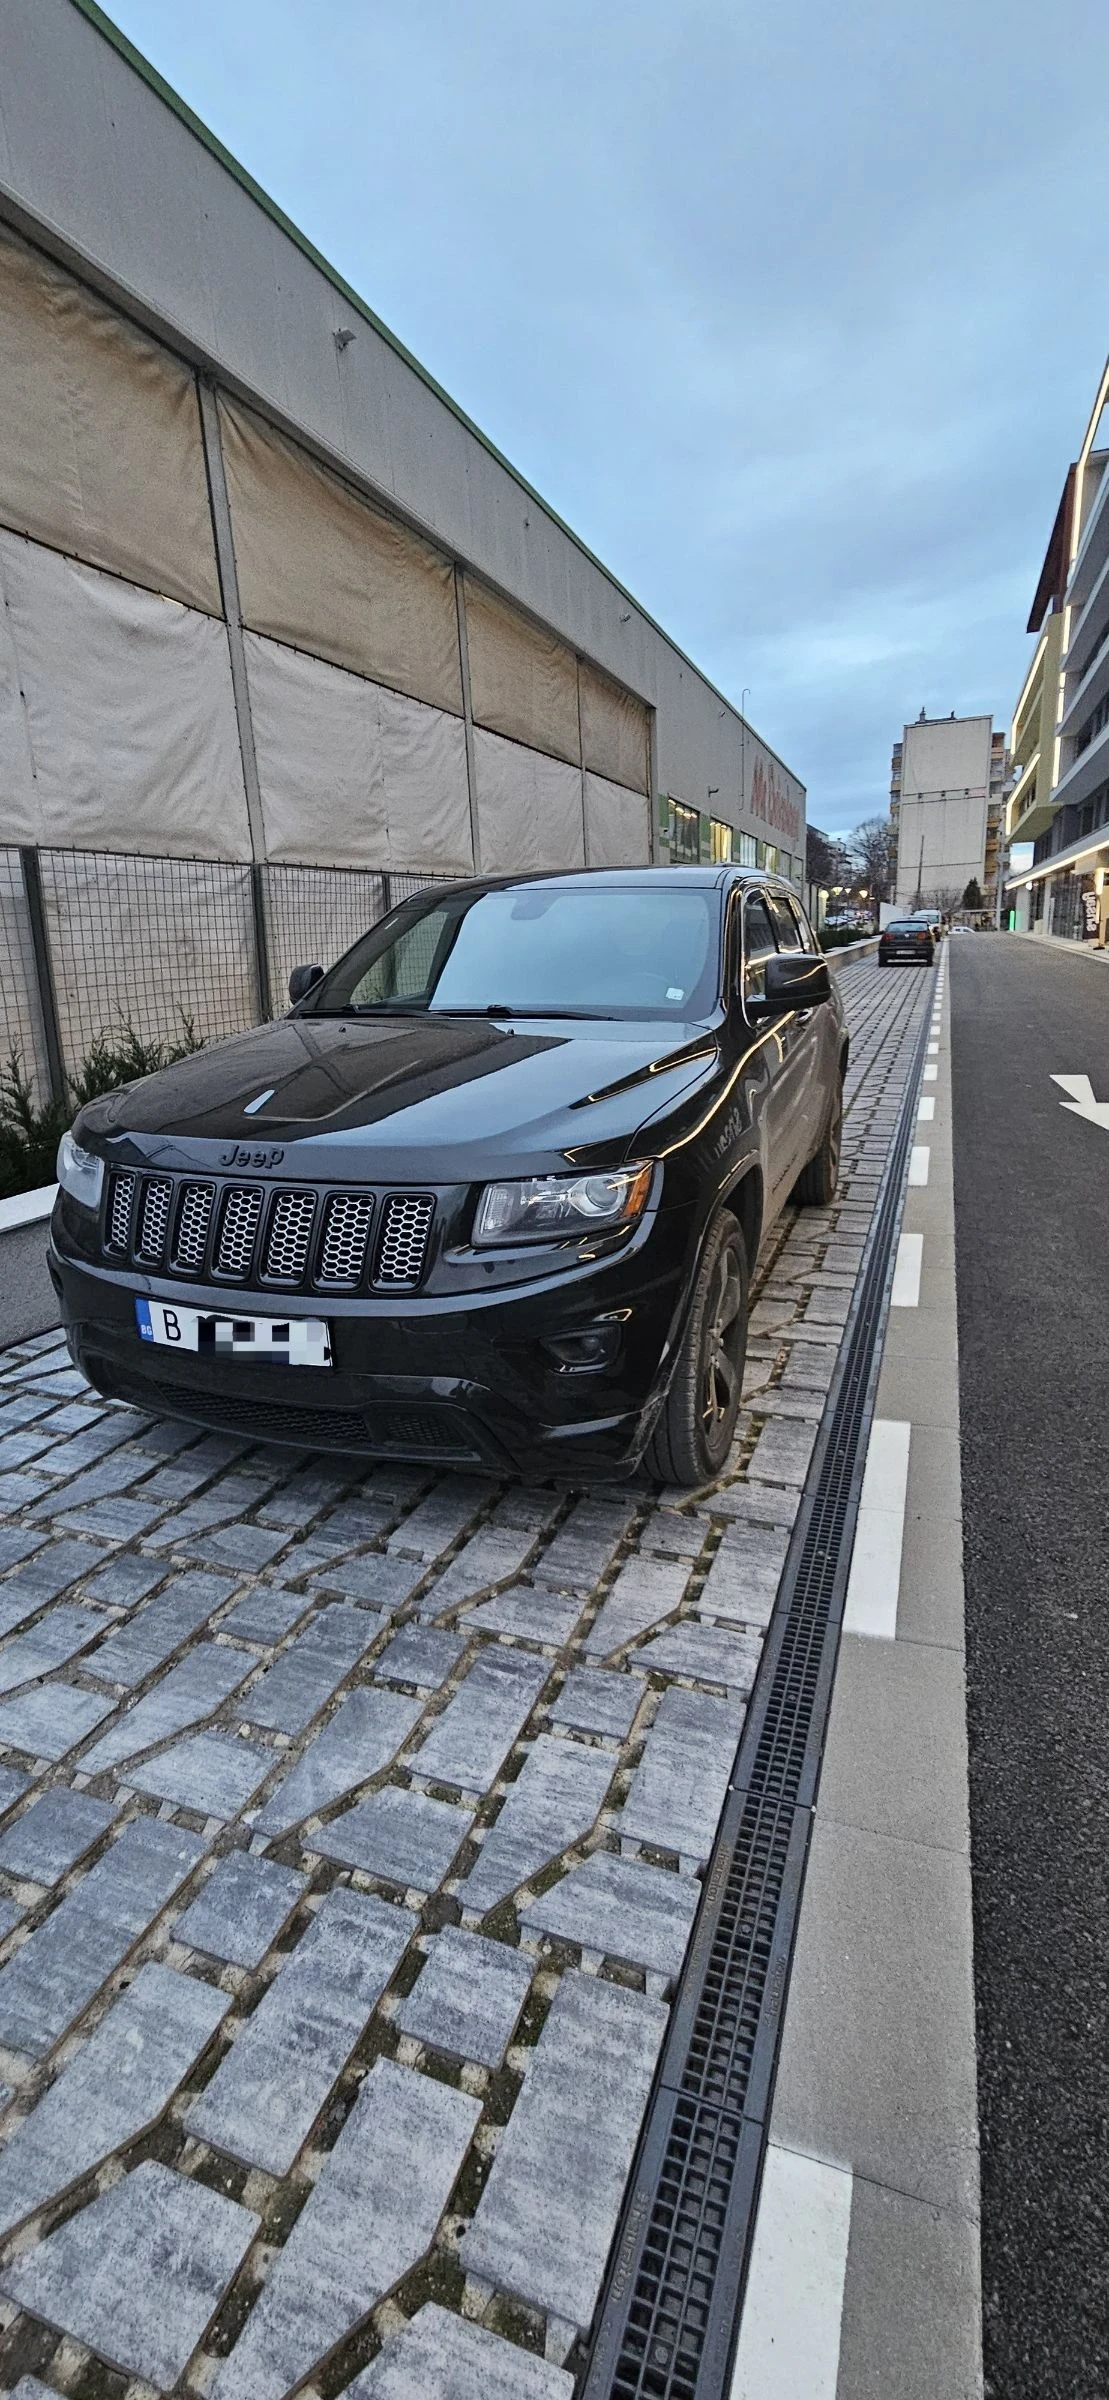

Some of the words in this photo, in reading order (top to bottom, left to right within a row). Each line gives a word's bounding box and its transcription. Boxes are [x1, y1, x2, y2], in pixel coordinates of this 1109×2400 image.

[219, 1145, 284, 1169] Jeep
[140, 1324, 153, 1336] BG
[162, 1309, 181, 1341] B
